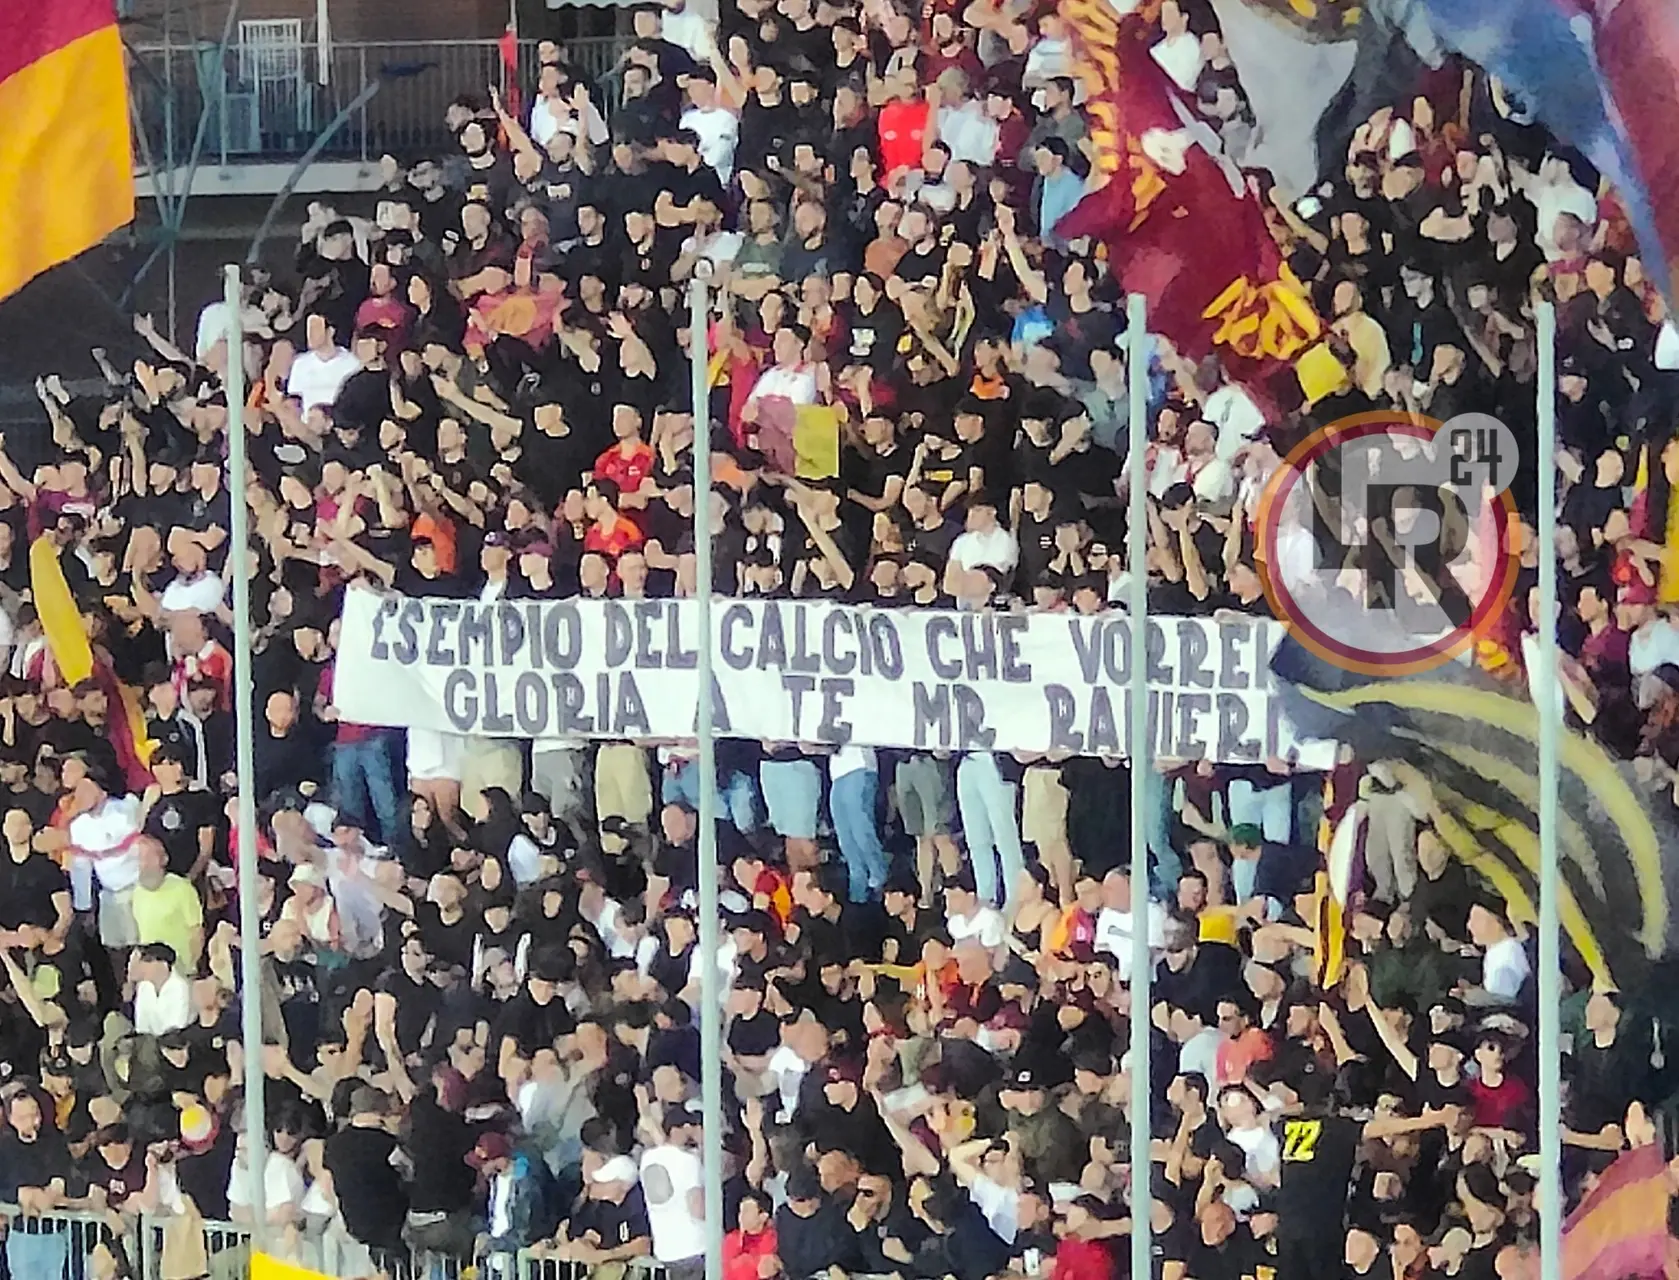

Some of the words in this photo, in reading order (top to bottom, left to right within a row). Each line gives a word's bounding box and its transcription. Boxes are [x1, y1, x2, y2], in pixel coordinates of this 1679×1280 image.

[371, 599, 582, 669] ESEMPIO
[604, 601, 698, 669] DEL
[721, 601, 905, 681] CALCIO
[926, 613, 1032, 682] CHE
[1068, 618, 1267, 689] VORREI
[444, 668, 652, 734] GLORIA
[692, 669, 732, 733] A
[782, 674, 855, 744] TE
[913, 680, 997, 748] MR
